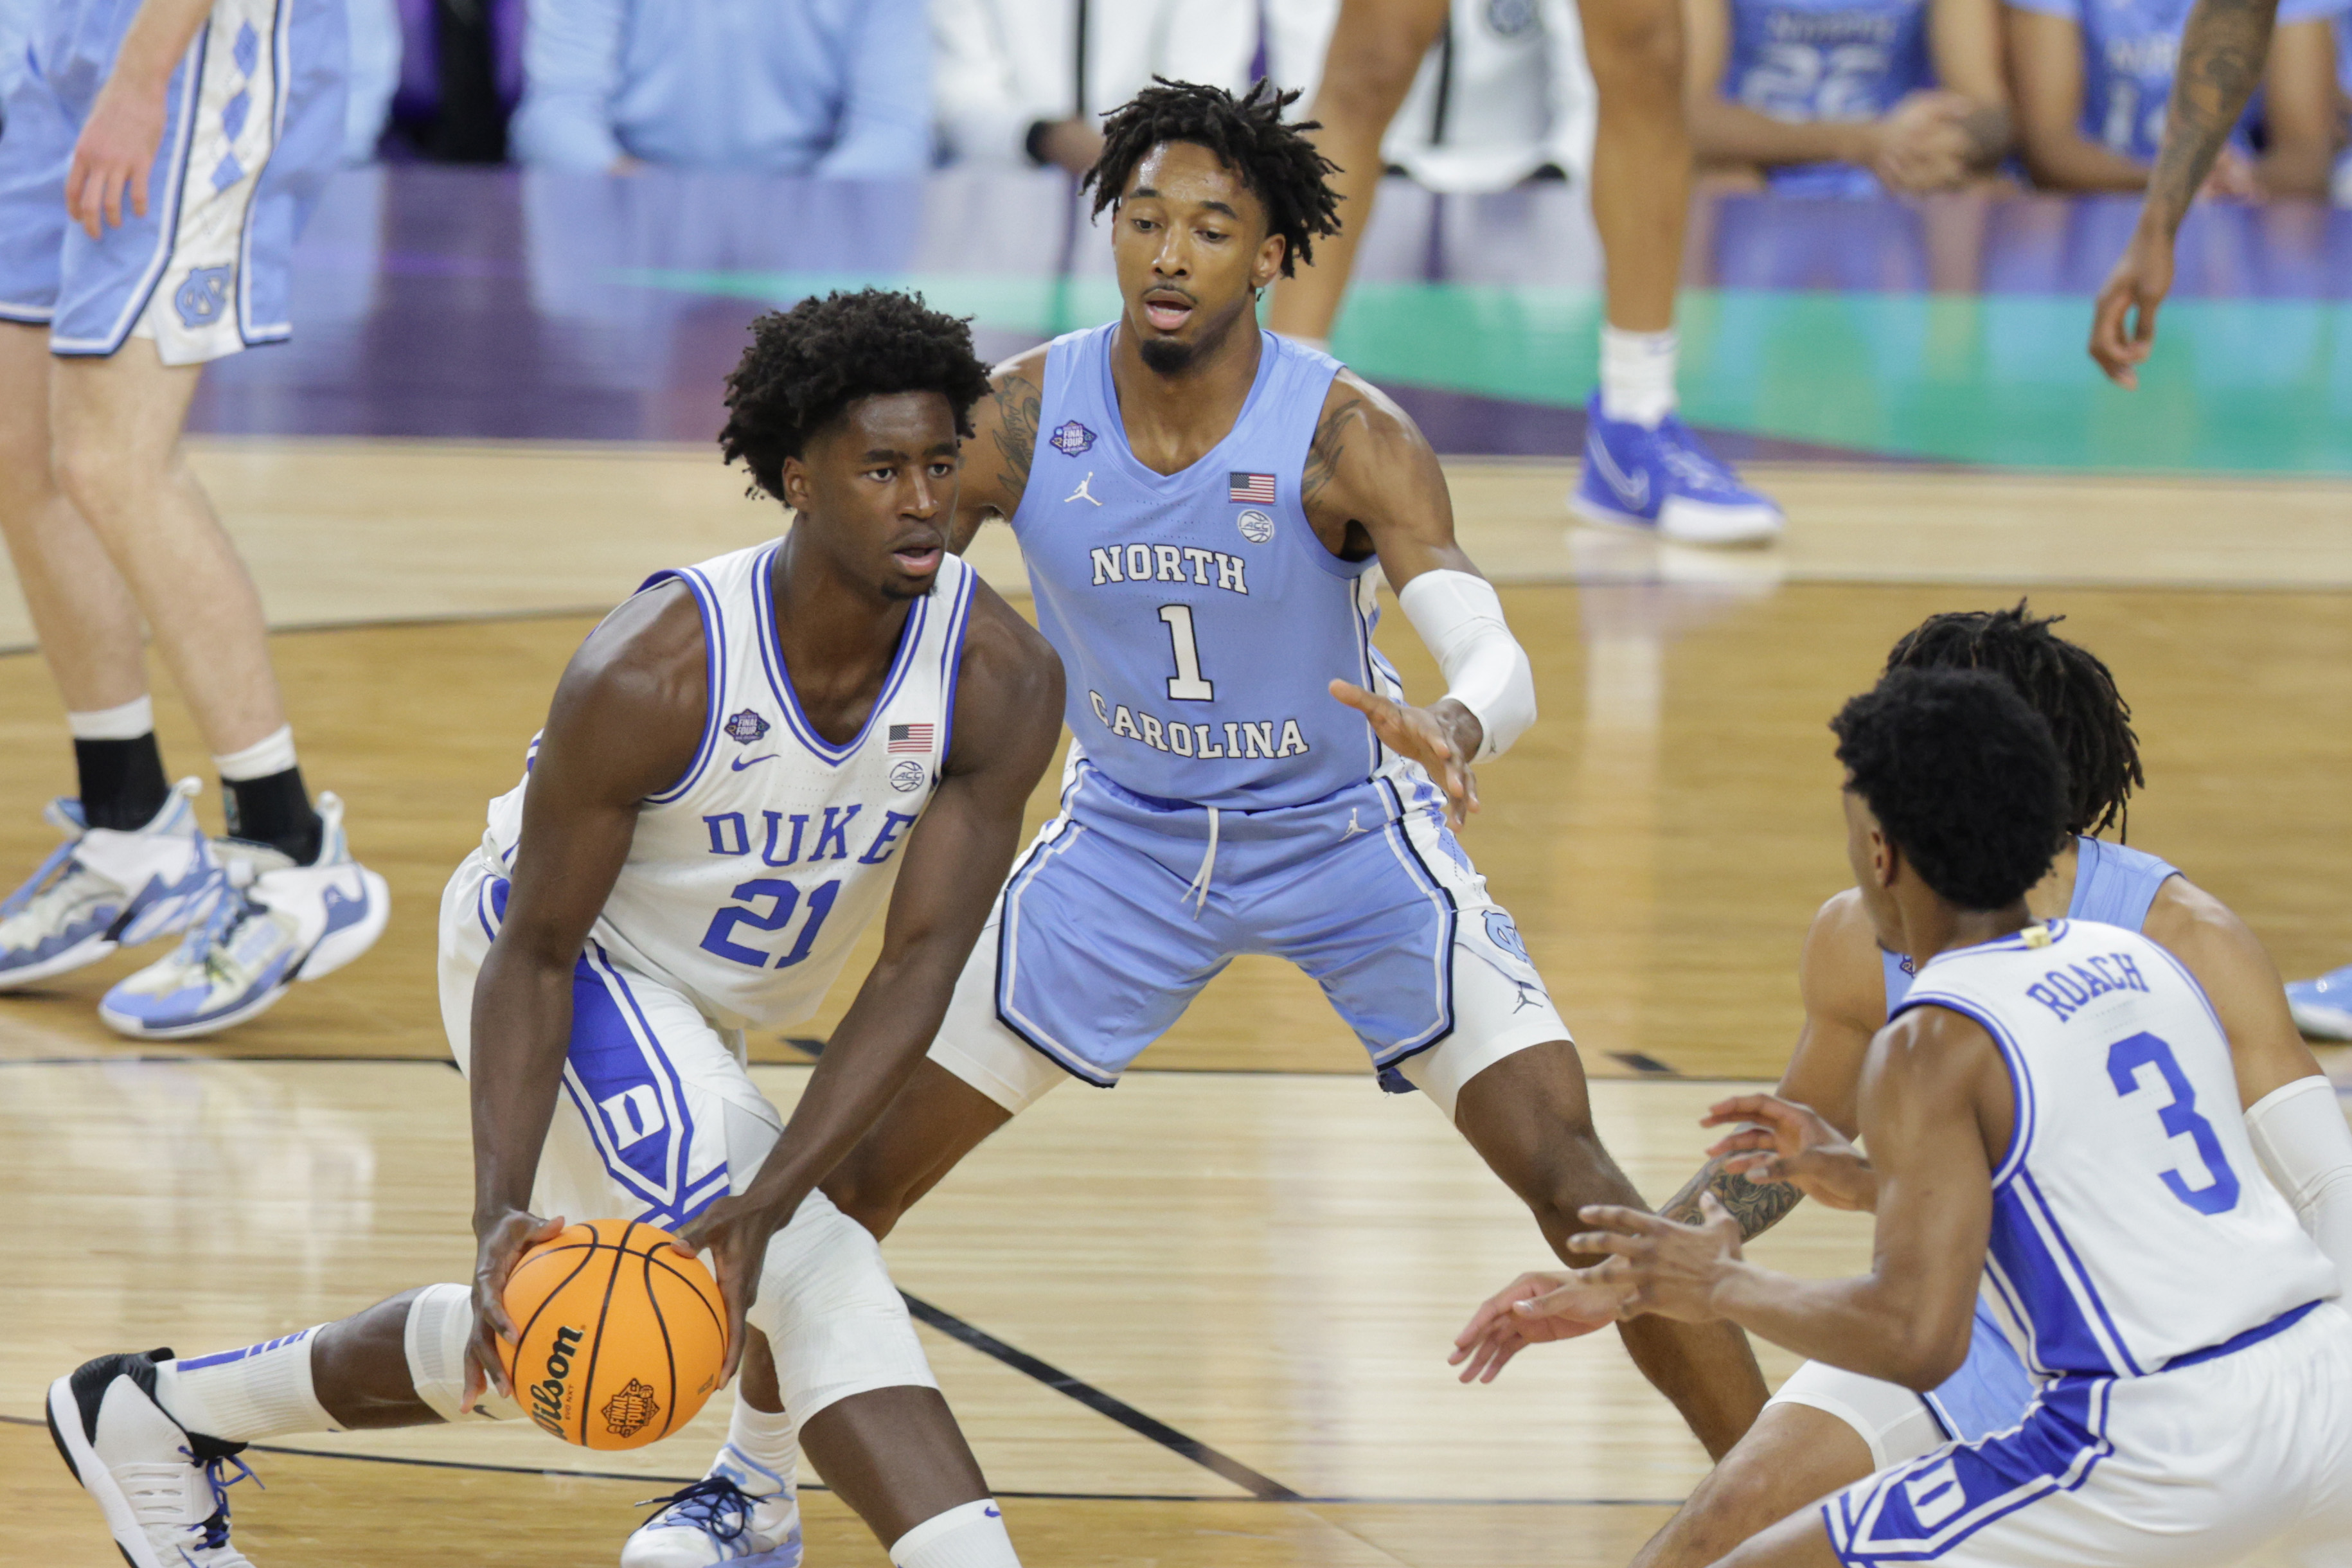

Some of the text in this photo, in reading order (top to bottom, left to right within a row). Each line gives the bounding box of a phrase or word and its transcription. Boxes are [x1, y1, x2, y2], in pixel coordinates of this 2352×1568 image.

[1062, 437, 1083, 448] FOUR
[1064, 429, 1083, 438] FINAL
[1244, 521, 1270, 530] ACC
[1091, 543, 1249, 595] NORTH
[1157, 603, 1214, 702] 1
[736, 726, 757, 736] FOUR
[738, 718, 758, 727] FINAL
[1089, 690, 1309, 759] CAROLINA
[702, 803, 919, 867] DUKE
[699, 878, 841, 969] 21
[2026, 952, 2151, 1023] ROACH
[2107, 1031, 2240, 1216] 3
[610, 1395, 628, 1425] FINAL
[626, 1395, 644, 1426] FOUR
